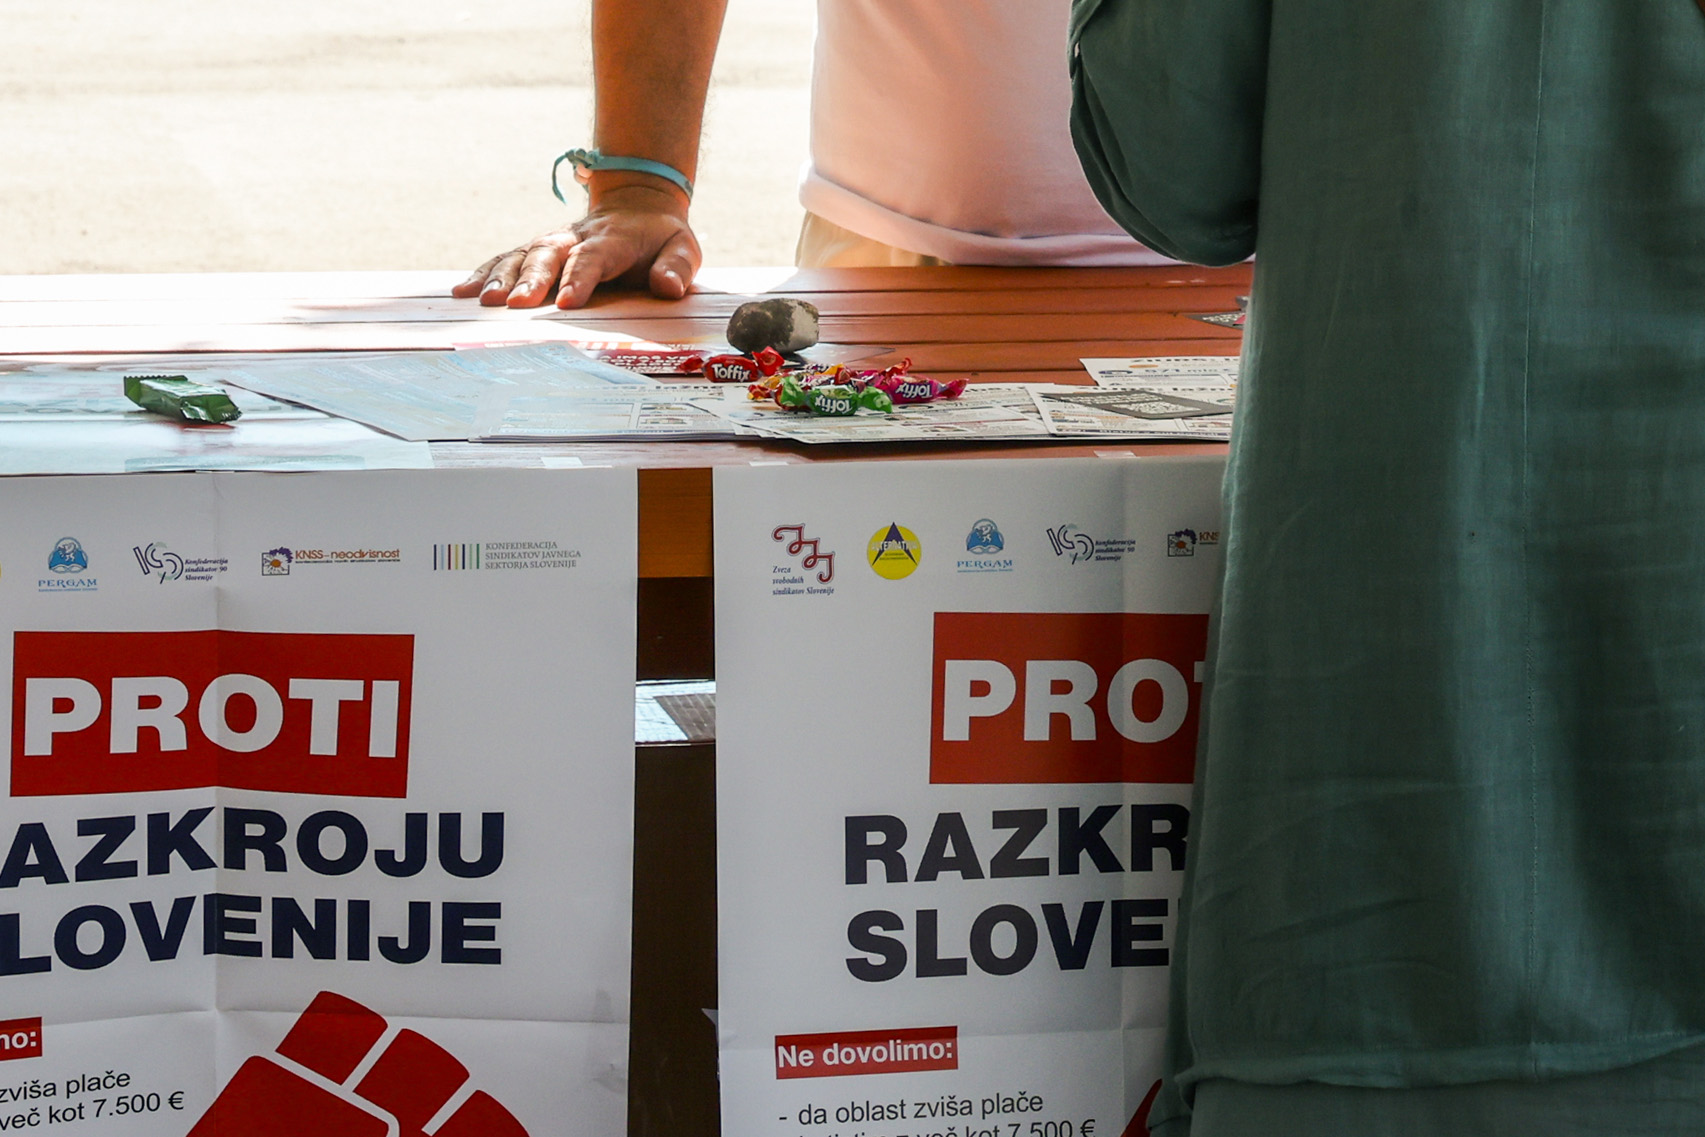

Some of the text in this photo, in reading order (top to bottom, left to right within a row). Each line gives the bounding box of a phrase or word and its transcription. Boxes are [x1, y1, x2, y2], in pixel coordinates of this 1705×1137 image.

[711, 363, 751, 382] Toffix
[815, 394, 852, 413] Toffix
[894, 382, 934, 398] Toffix
[485, 542, 558, 551] KONFEDERACIJA
[486, 550, 582, 560] SINDIKATOV JAVNEGA
[486, 560, 577, 569] SEKTORJA SLOVENIJE
[957, 559, 1013, 569] PERGAM
[38, 578, 97, 588] PERGAM
[24, 673, 400, 758] PROTI
[943, 658, 1205, 743] PRO
[0, 806, 505, 889] AZKROJU
[844, 802, 1192, 885] RAZKR
[0, 892, 502, 976] LOVENIJE
[845, 898, 1183, 982] SLOVE
[778, 1039, 953, 1067] Ne dovolimo:
[0, 1070, 130, 1103] zviša plače
[0, 1091, 185, 1131] več kot 7.500 €
[798, 1103, 827, 1125] da
[835, 1099, 906, 1123] oblast
[914, 1095, 972, 1119] zviša
[981, 1091, 1043, 1119] plače
